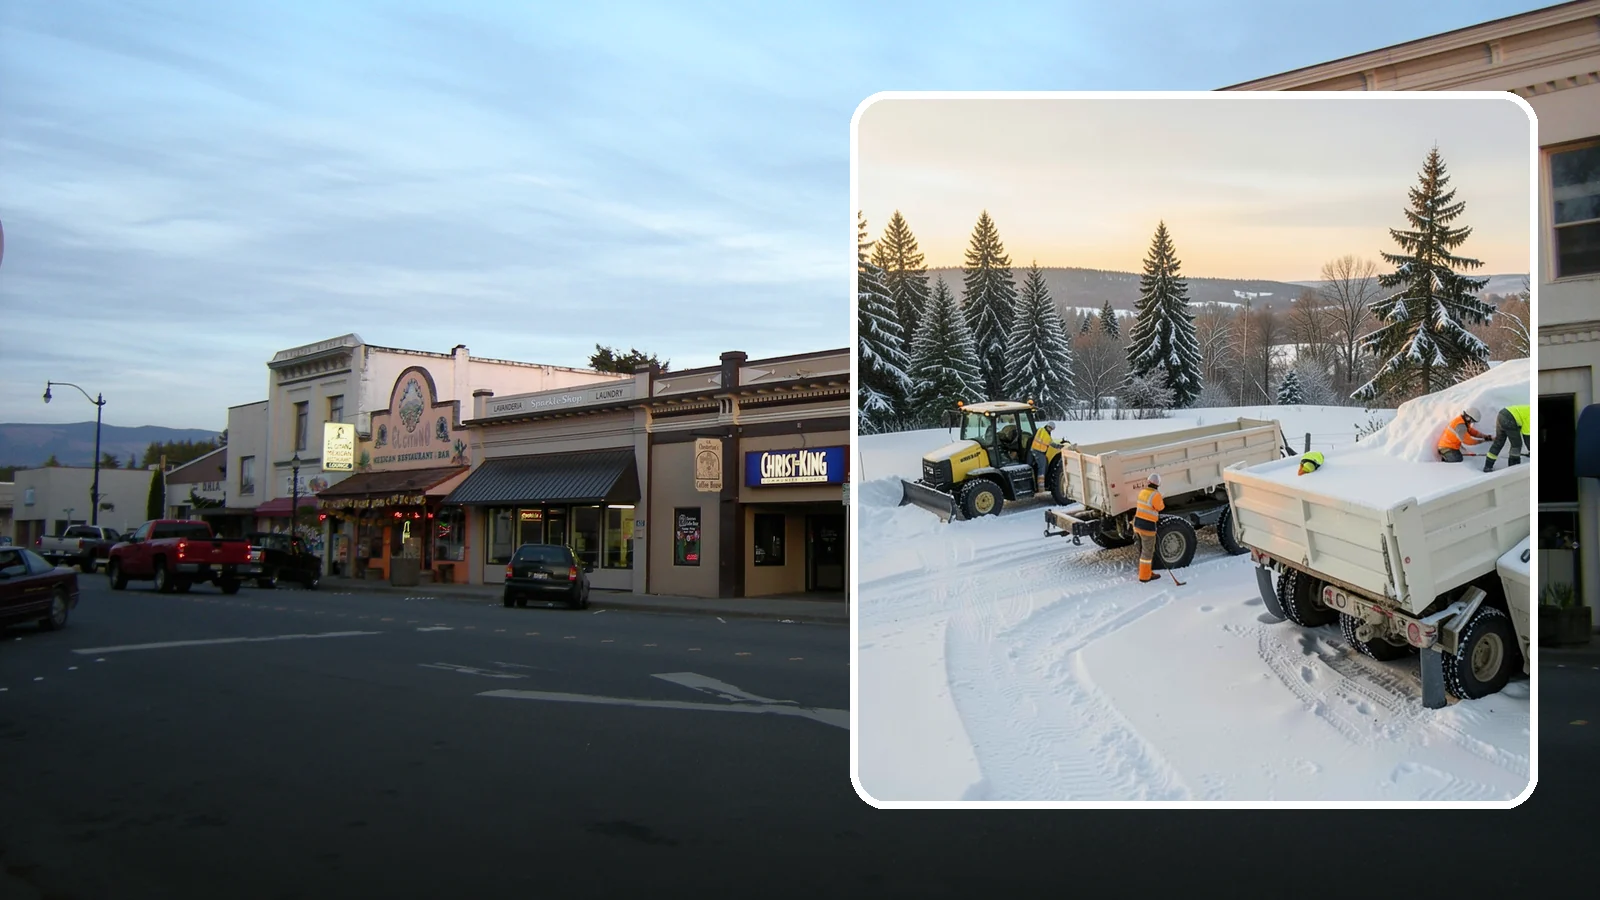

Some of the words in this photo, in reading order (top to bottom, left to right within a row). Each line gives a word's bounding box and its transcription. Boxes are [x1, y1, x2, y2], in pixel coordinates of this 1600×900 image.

[493, 402, 523, 413] LAVANDERIA
[531, 396, 561, 408] Sparkle
[562, 394, 582, 404] Shop
[595, 389, 624, 400] LAUNDRY
[373, 455, 396, 464] MEXICAN
[397, 451, 433, 462] RESTAURANT
[438, 450, 450, 459] BAR
[761, 452, 797, 478] CHRIST
[799, 450, 827, 476] KING
[696, 480, 709, 488] Coffee
